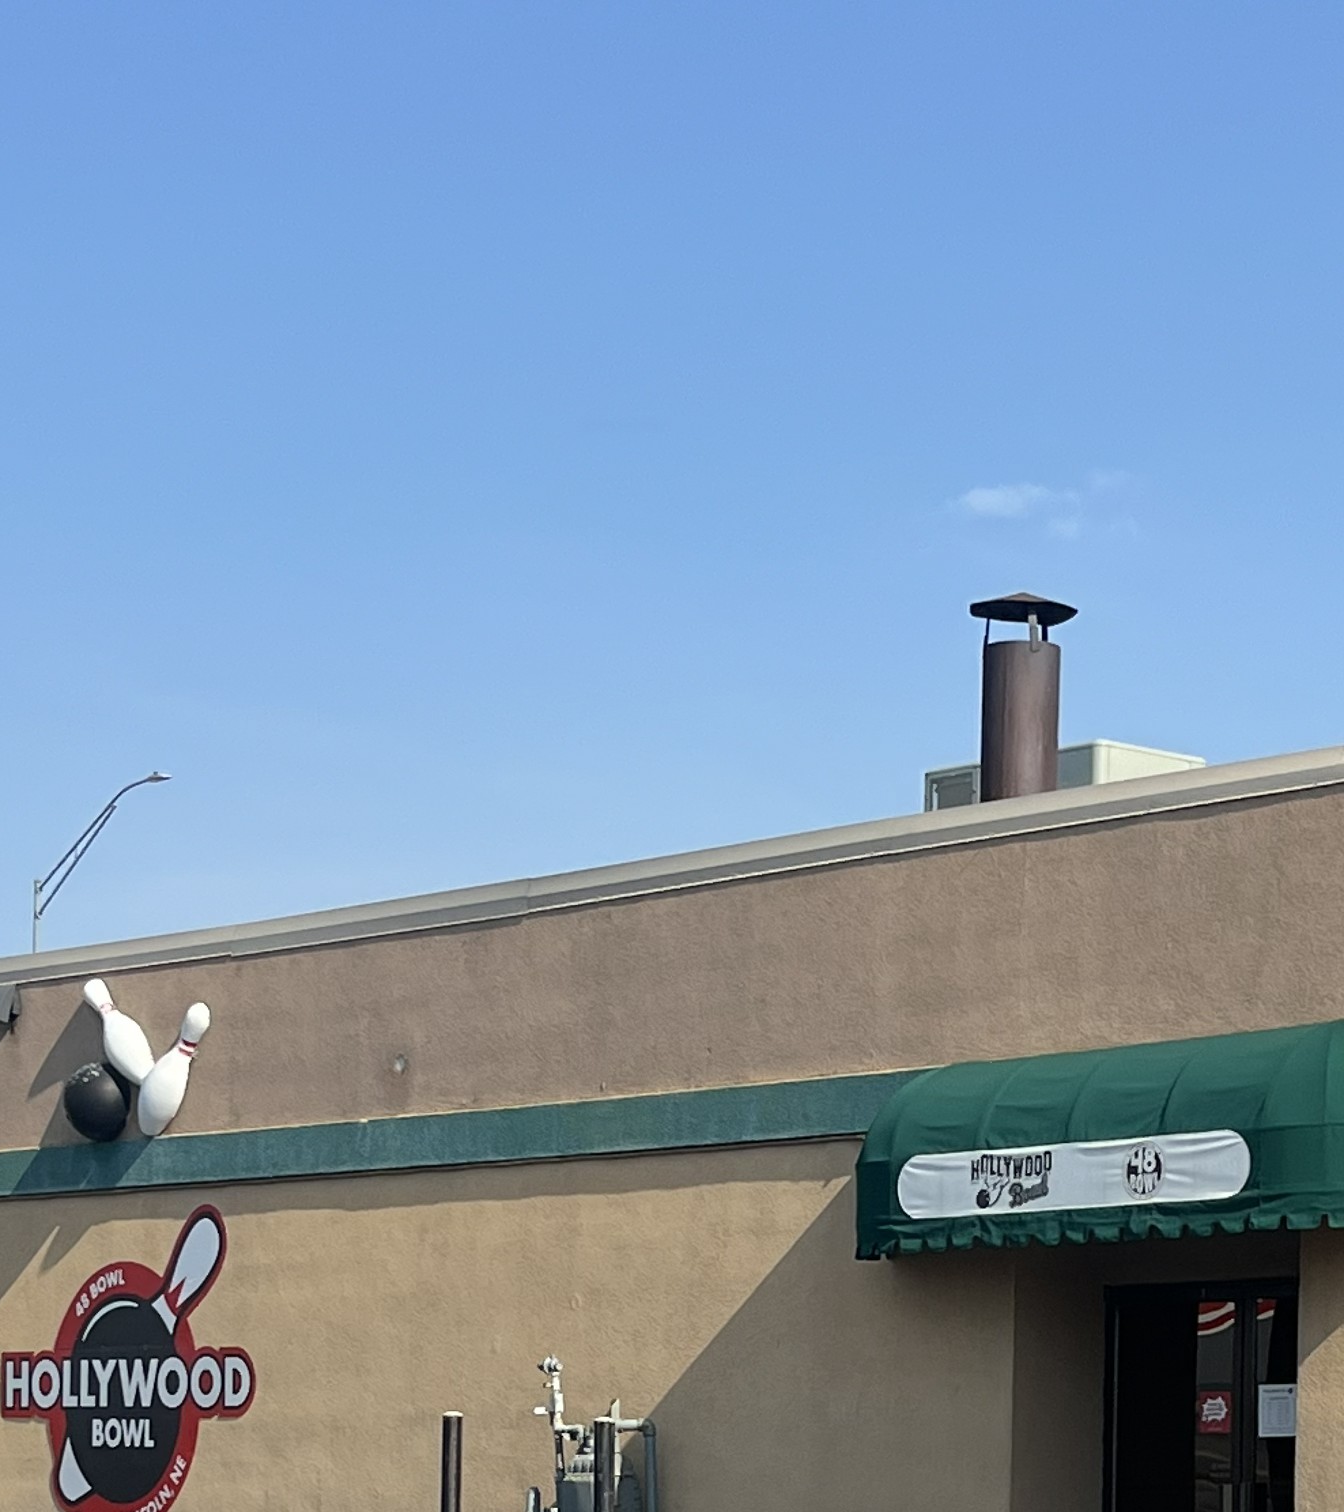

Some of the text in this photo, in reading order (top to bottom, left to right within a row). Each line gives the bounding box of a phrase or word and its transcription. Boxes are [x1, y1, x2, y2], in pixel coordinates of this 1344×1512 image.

[971, 1151, 1052, 1180] HOLLYWOOD
[89, 1269, 125, 1299] BOWL
[5, 1356, 251, 1408] HOLLYWOOD
[91, 1418, 155, 1448] BOWL
[169, 1454, 187, 1486] NE
